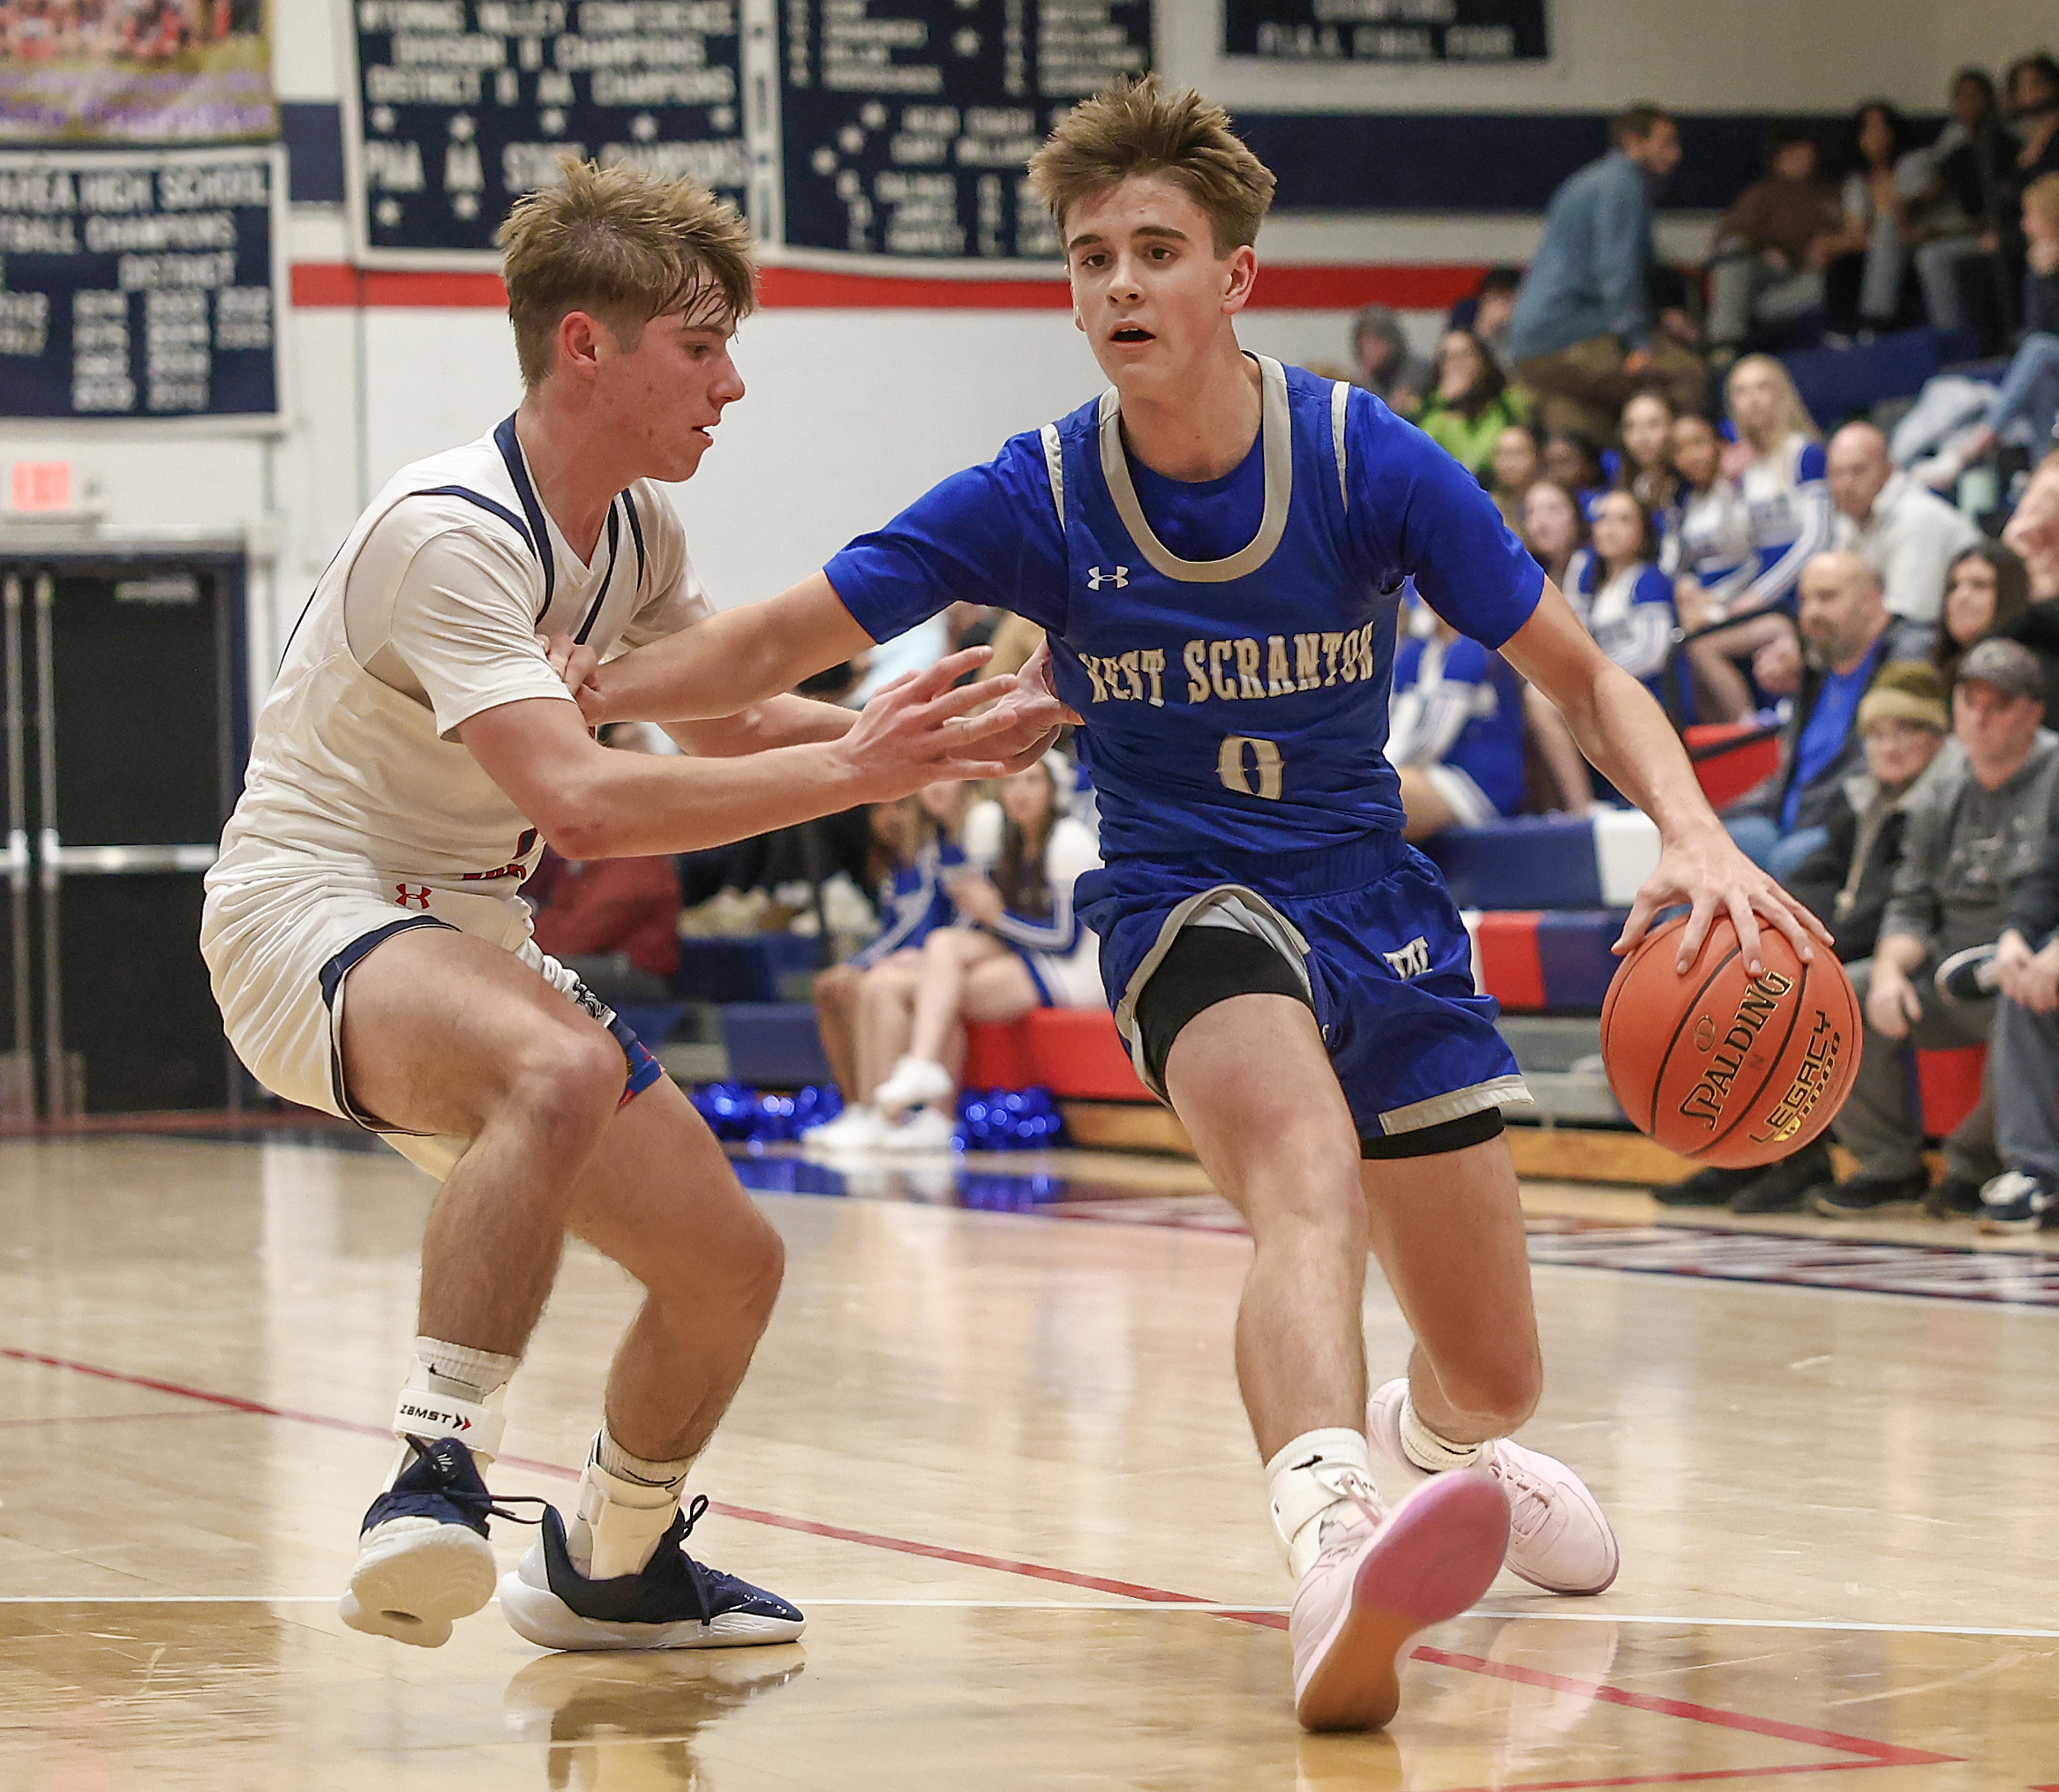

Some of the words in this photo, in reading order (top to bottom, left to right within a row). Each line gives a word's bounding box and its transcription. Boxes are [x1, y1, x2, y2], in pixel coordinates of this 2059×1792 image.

[393, 33, 507, 68] DIVISION
[553, 34, 704, 71] CHAMPIONS
[367, 65, 481, 104] DISTRICT
[590, 66, 735, 106] CHAMPIONS
[159, 164, 268, 208] SCHOOL
[85, 212, 237, 252] CHAMPIONS
[1214, 734, 1286, 800] 0
[1679, 967, 1795, 1131] SPALDING
[1748, 1009, 1832, 1143] LEGACY
